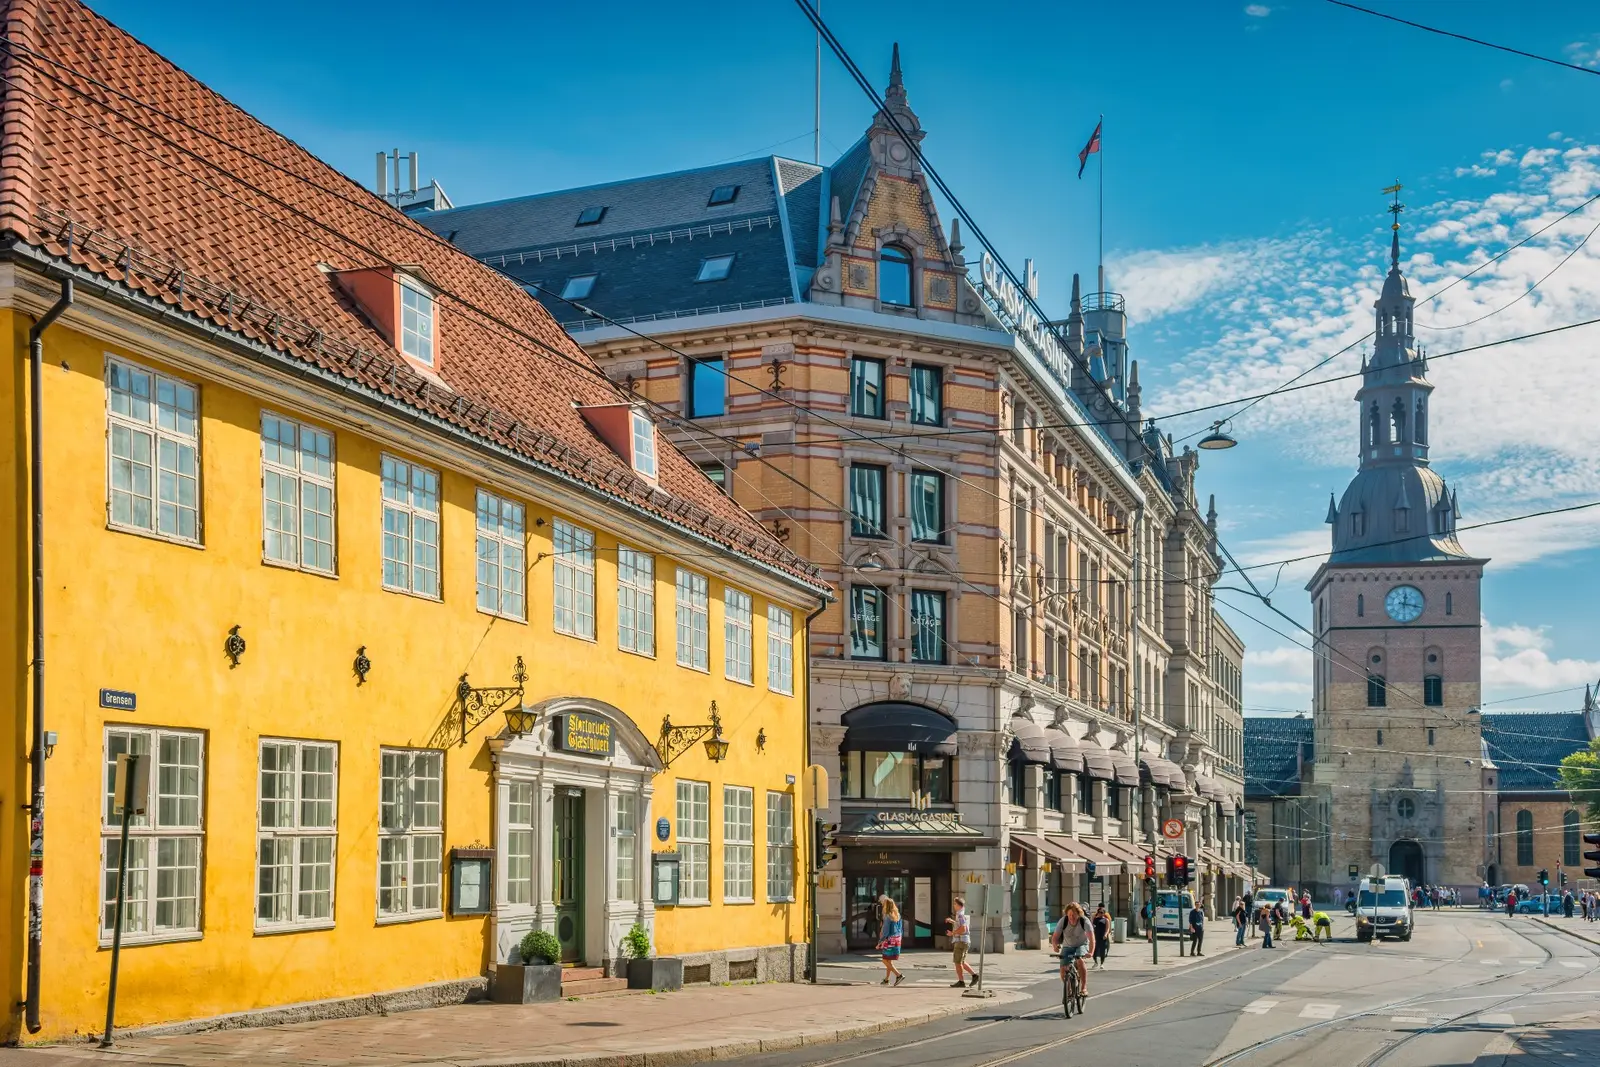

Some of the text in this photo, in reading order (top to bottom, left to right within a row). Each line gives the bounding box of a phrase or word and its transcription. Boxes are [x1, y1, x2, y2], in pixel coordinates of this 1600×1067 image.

[981, 251, 1073, 388] GLASMAGASINET
[105, 692, 133, 705] Grensen
[878, 812, 965, 822] GLASMAGASINET
